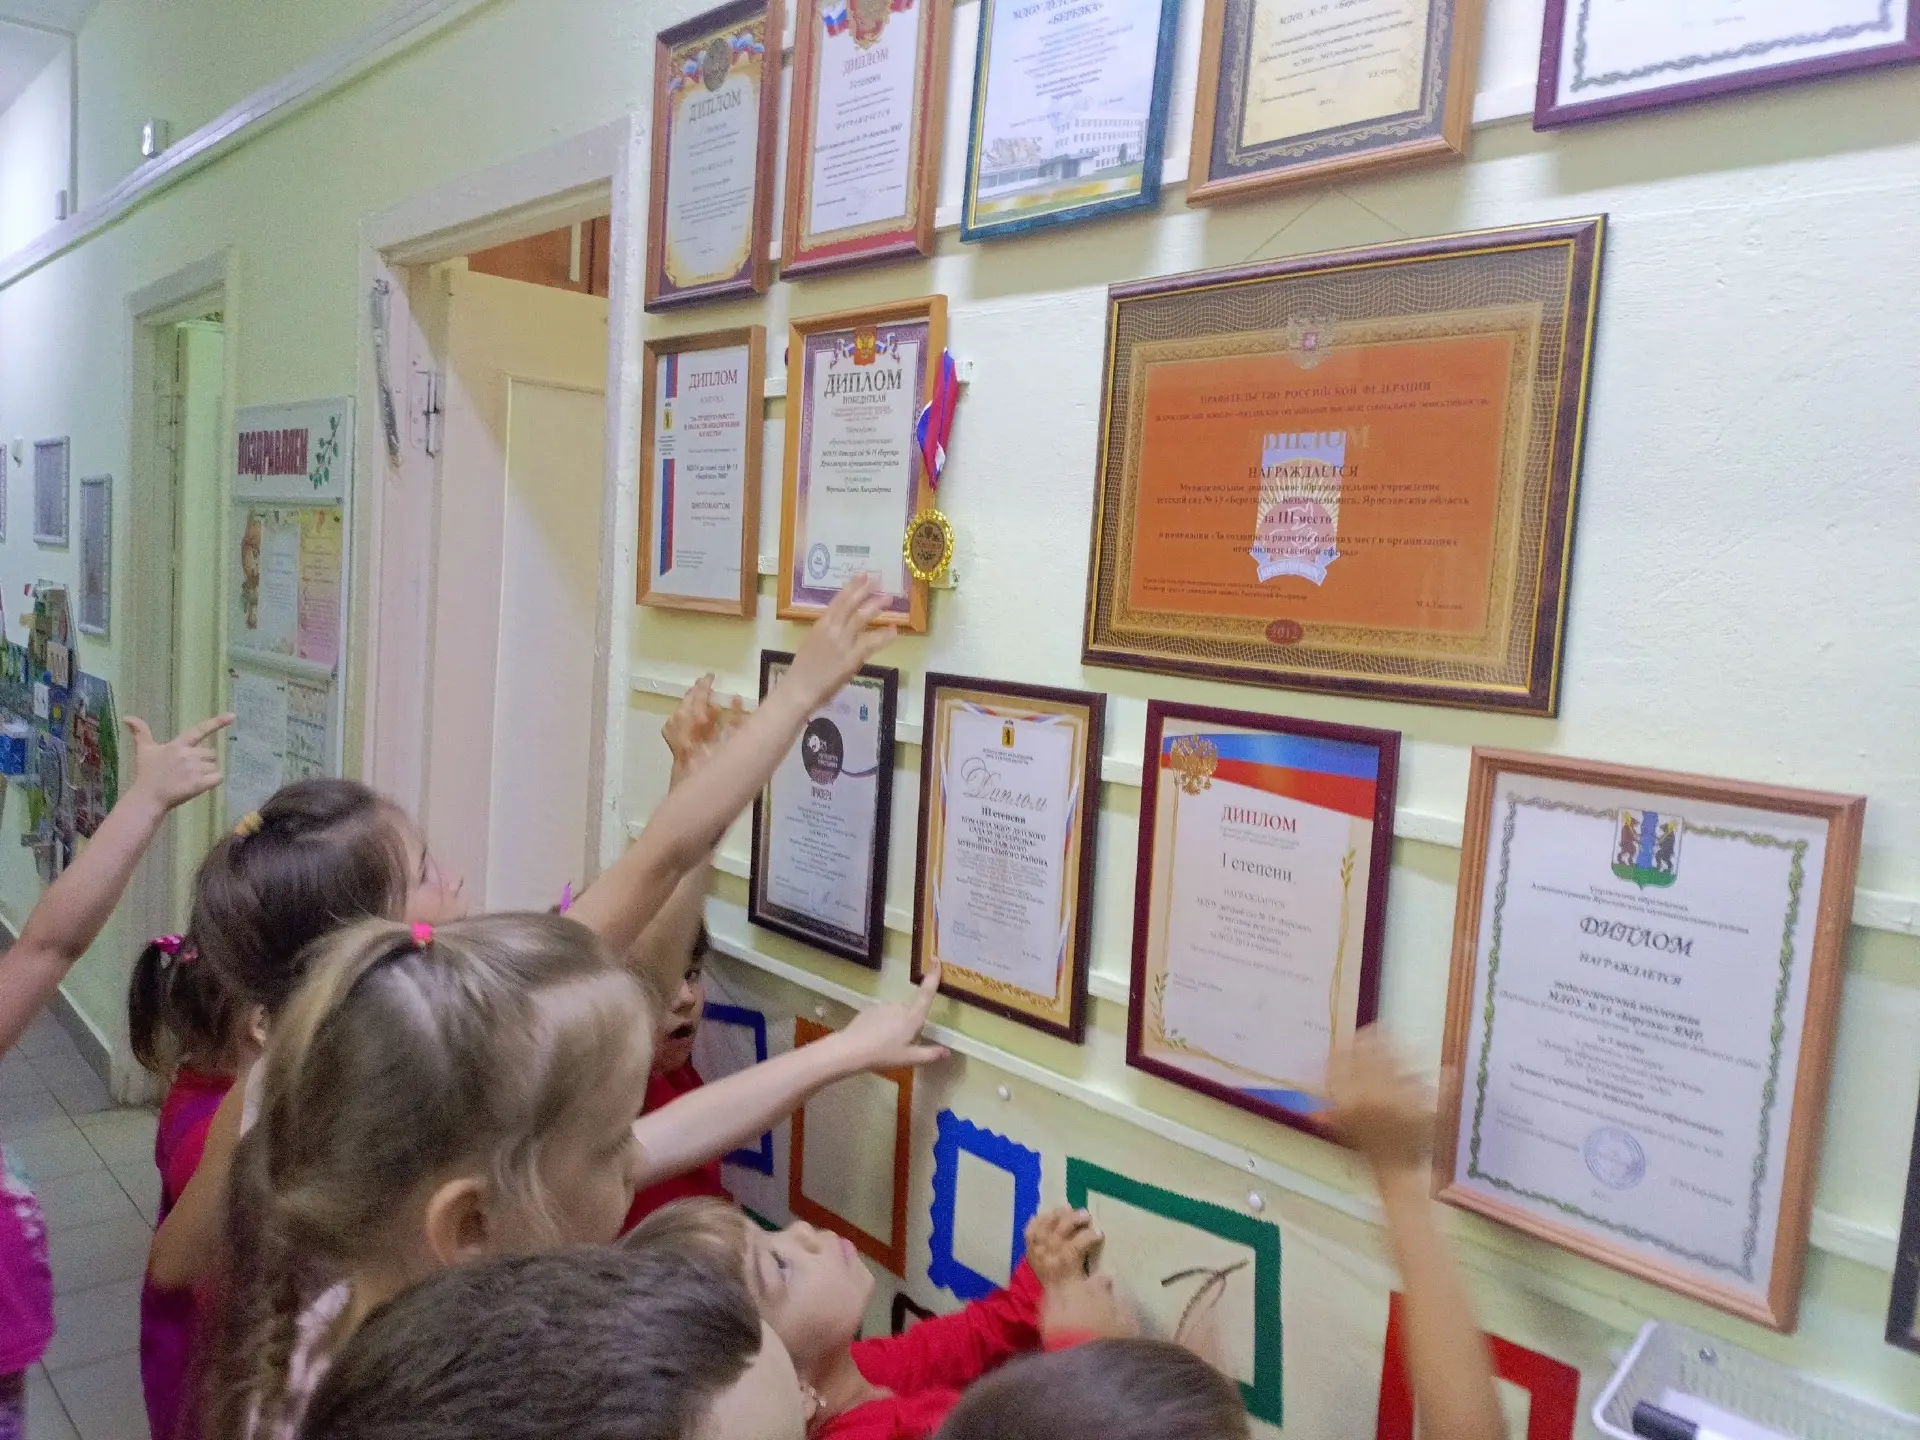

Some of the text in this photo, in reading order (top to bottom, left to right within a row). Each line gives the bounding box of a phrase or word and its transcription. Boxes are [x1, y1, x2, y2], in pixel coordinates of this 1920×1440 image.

[842, 47, 889, 76] ДИПЛОМ
[688, 88, 742, 125] ДИПЛОМ
[688, 368, 739, 392] ДИПЛОМ
[824, 368, 903, 399] ДИПЛОМ
[1200, 381, 1431, 404] ПРАВИТЕЛЬСТВО РОССИЙСКОЙ ФЕДЕРАЦИИ
[842, 394, 887, 405] ПОБЕДИТЕЛЯ
[1248, 464, 1358, 480] НАГРАЖДАЕТСЯ
[1180, 482, 1440, 493] Муниципальное дошкольное образовательное учреждение
[1157, 495, 1187, 505] детский
[1202, 496, 1213, 504] №
[1363, 495, 1426, 507] Ярославская
[1429, 496, 1469, 505] область
[1278, 512, 1294, 524] III
[1298, 516, 1332, 524] место
[1226, 533, 1263, 543] создание
[1272, 535, 1311, 543] развитие
[1314, 535, 1351, 544] рабочих
[1233, 547, 1321, 557] непроизводственной
[961, 756, 1048, 813] Диплом
[961, 815, 995, 828] КОМАНДА
[1012, 826, 1047, 841] ДЕТСКОГО
[992, 809, 1026, 825] степени
[1220, 804, 1297, 833] ДИПЛОМ
[957, 838, 1048, 867] МУНИЦИПАЛЬНОГО РАЙОНА
[1221, 852, 1292, 883] I степени
[1223, 887, 1286, 910] НАГРАЖДАЕТСЯ
[1531, 882, 1750, 935] Администрации Ярославского муниципального района
[1589, 883, 1689, 912] Управление образования
[1268, 915, 1276, 924] 19
[1580, 915, 1694, 957] ДИПЛОМ
[1579, 951, 1683, 987] НАГРАЖДАЕТСЯ
[1548, 990, 1583, 1008] МДОУ
[1586, 999, 1599, 1012] №
[1614, 1010, 1672, 1034] «Березка»
[1638, 999, 1701, 1026] коллектив
